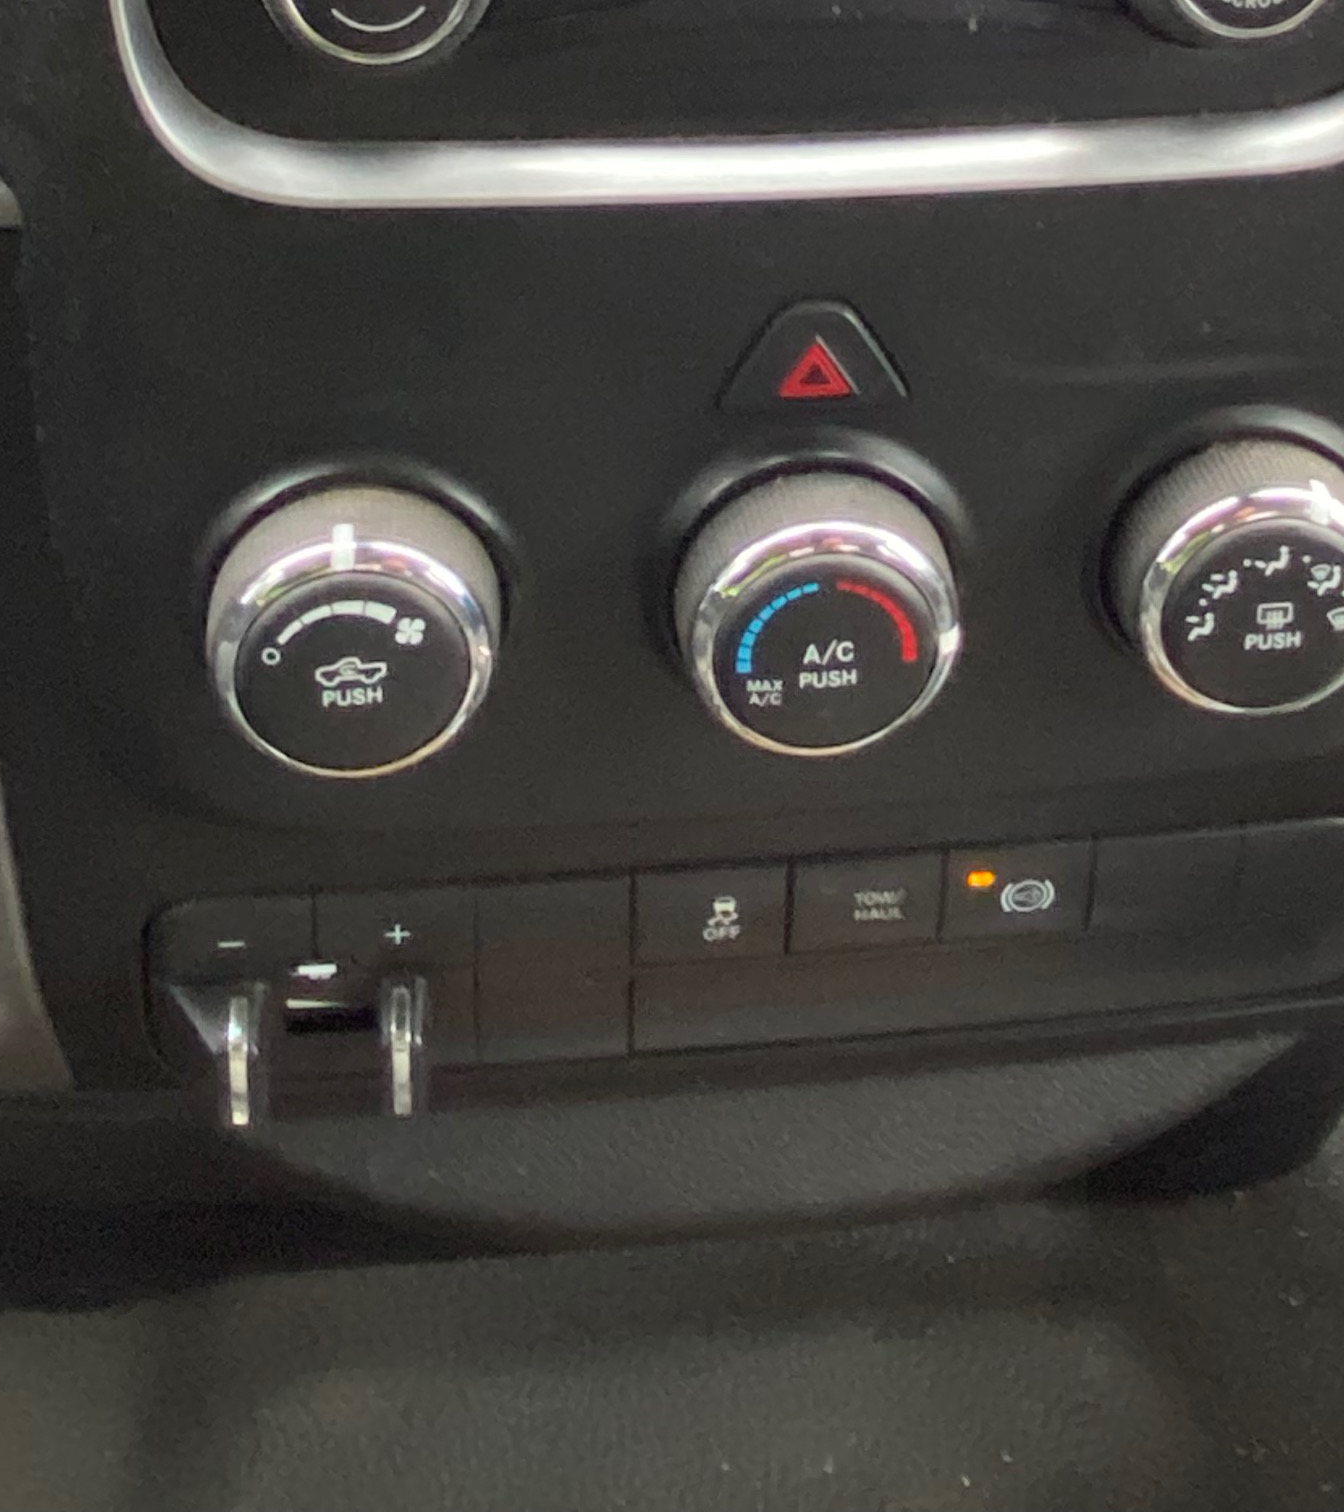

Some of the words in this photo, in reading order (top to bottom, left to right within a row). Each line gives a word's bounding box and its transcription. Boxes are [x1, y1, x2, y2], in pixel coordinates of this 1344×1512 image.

[1243, 631, 1303, 651] PUSH
[802, 639, 855, 666] A/C
[746, 679, 784, 693] MAX
[799, 669, 858, 690] PUSH
[321, 687, 384, 708] PUSH
[748, 691, 783, 707] A/C
[853, 907, 906, 921] HAUL
[702, 925, 742, 943] OFF
